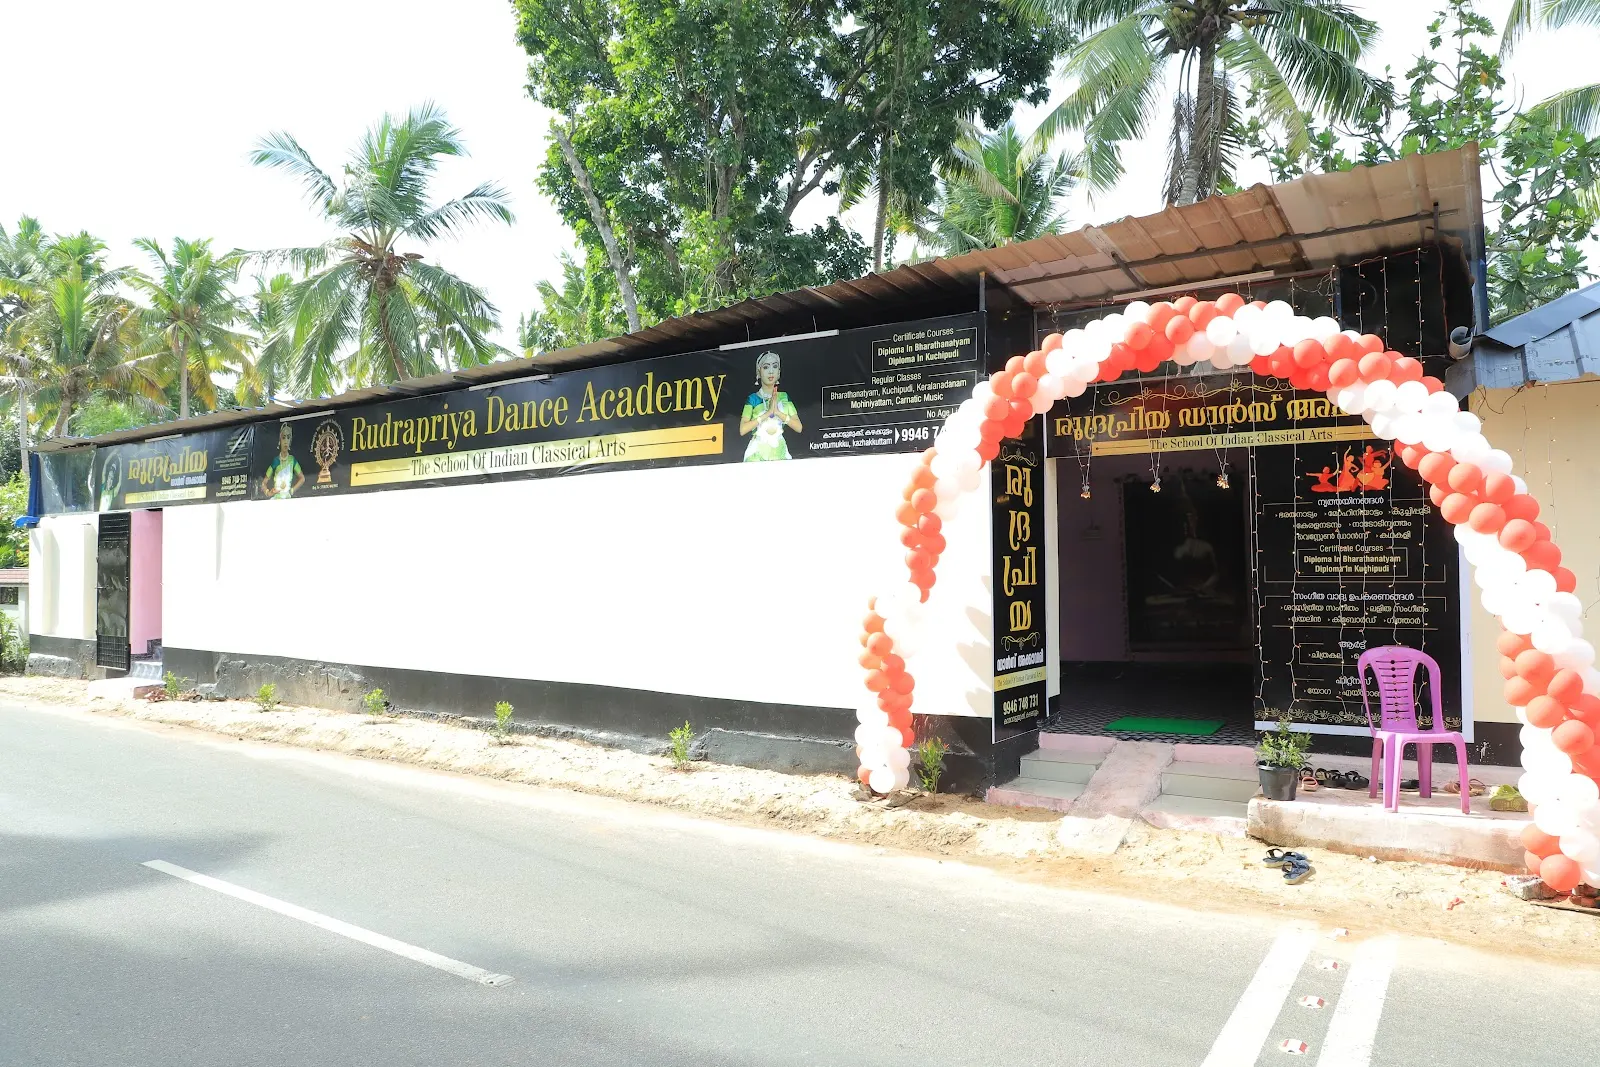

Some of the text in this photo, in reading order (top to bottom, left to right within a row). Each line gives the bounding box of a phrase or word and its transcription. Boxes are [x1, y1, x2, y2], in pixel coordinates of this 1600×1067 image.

[893, 327, 954, 343] Certificate Courses
[877, 337, 971, 357] Diploma In Bharathanatyam
[888, 349, 959, 366] Diploma In Kuchipudi
[871, 372, 922, 386] Regular Classes
[882, 384, 915, 396] Kuchipudi,
[917, 378, 967, 391] Keralanadanam
[895, 395, 922, 405] Carnatic
[923, 392, 944, 402] Music
[350, 403, 478, 454] Rudrapriya
[485, 395, 568, 435] Dance
[576, 371, 726, 422] Academy
[926, 410, 936, 418] No
[937, 407, 950, 418] Age
[1054, 406, 1171, 441] രുദ്രപ്രിയ
[1178, 394, 1283, 427] ഡാൻസ്
[901, 427, 929, 442] 9946
[1150, 429, 1333, 450] The School Of Indian Classical Arts
[128, 445, 209, 485] രുദ്രപ്രിയ
[411, 438, 626, 476] The School Of Indian Classical Arts
[1319, 544, 1384, 553] Certificate Courses
[1303, 555, 1401, 564] Diploma In Bharathanatyam
[1315, 564, 1390, 574] Diploma In Kuchipudi
[1003, 693, 1039, 716] 9946 748 731
